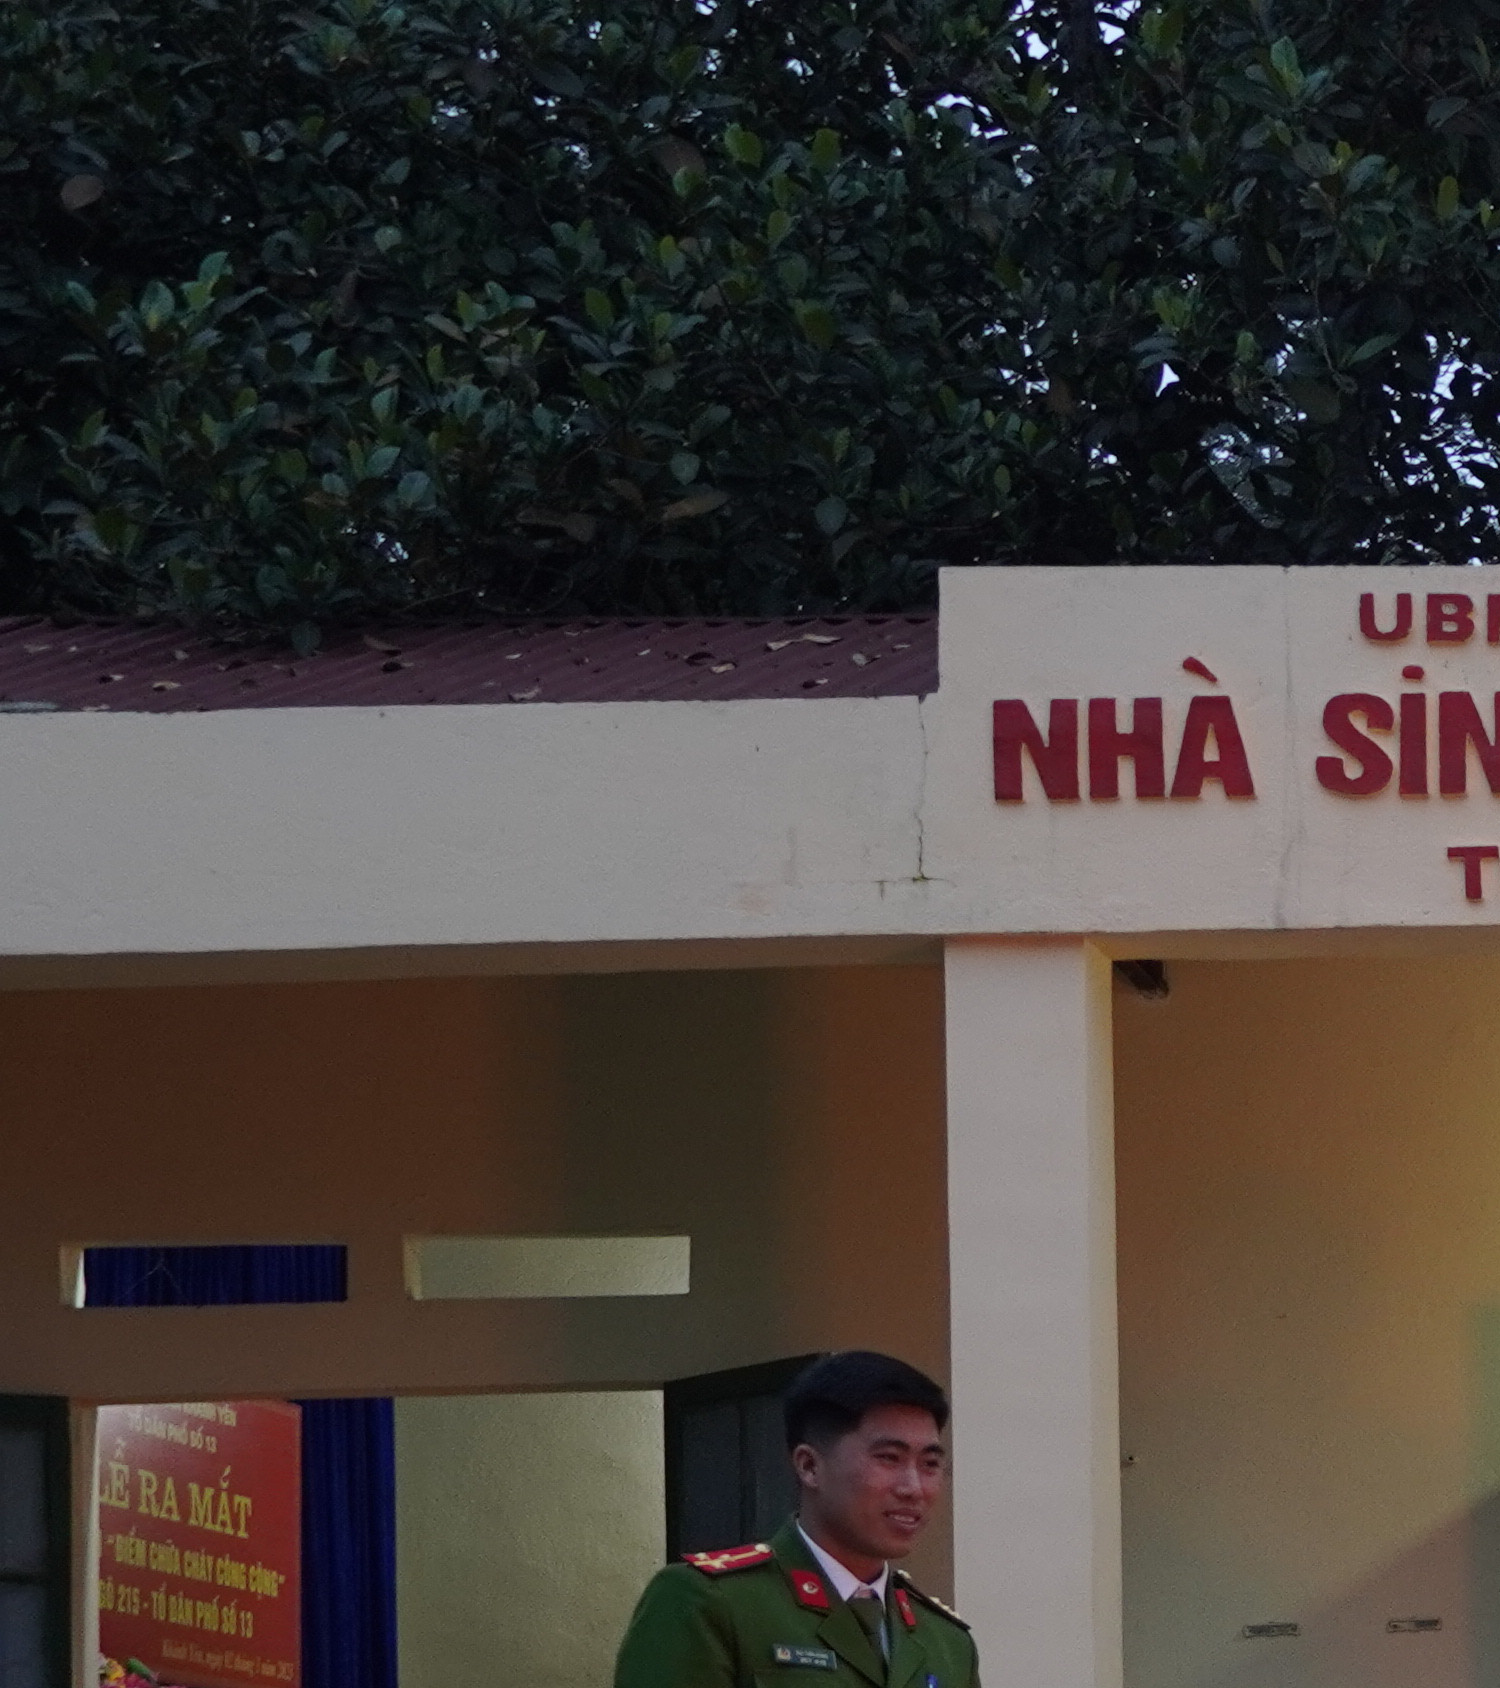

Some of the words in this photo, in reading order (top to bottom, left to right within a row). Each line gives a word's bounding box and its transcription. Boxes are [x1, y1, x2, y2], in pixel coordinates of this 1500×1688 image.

[993, 656, 1255, 802] NHÀ
[137, 1468, 181, 1521] RA
[187, 1465, 252, 1538] MẮT
[117, 1583, 140, 1615] 215
[168, 1591, 194, 1626] DÂN
[196, 1595, 219, 1631] PHỐ
[221, 1599, 237, 1635] SỐ
[239, 1610, 253, 1638] 13
